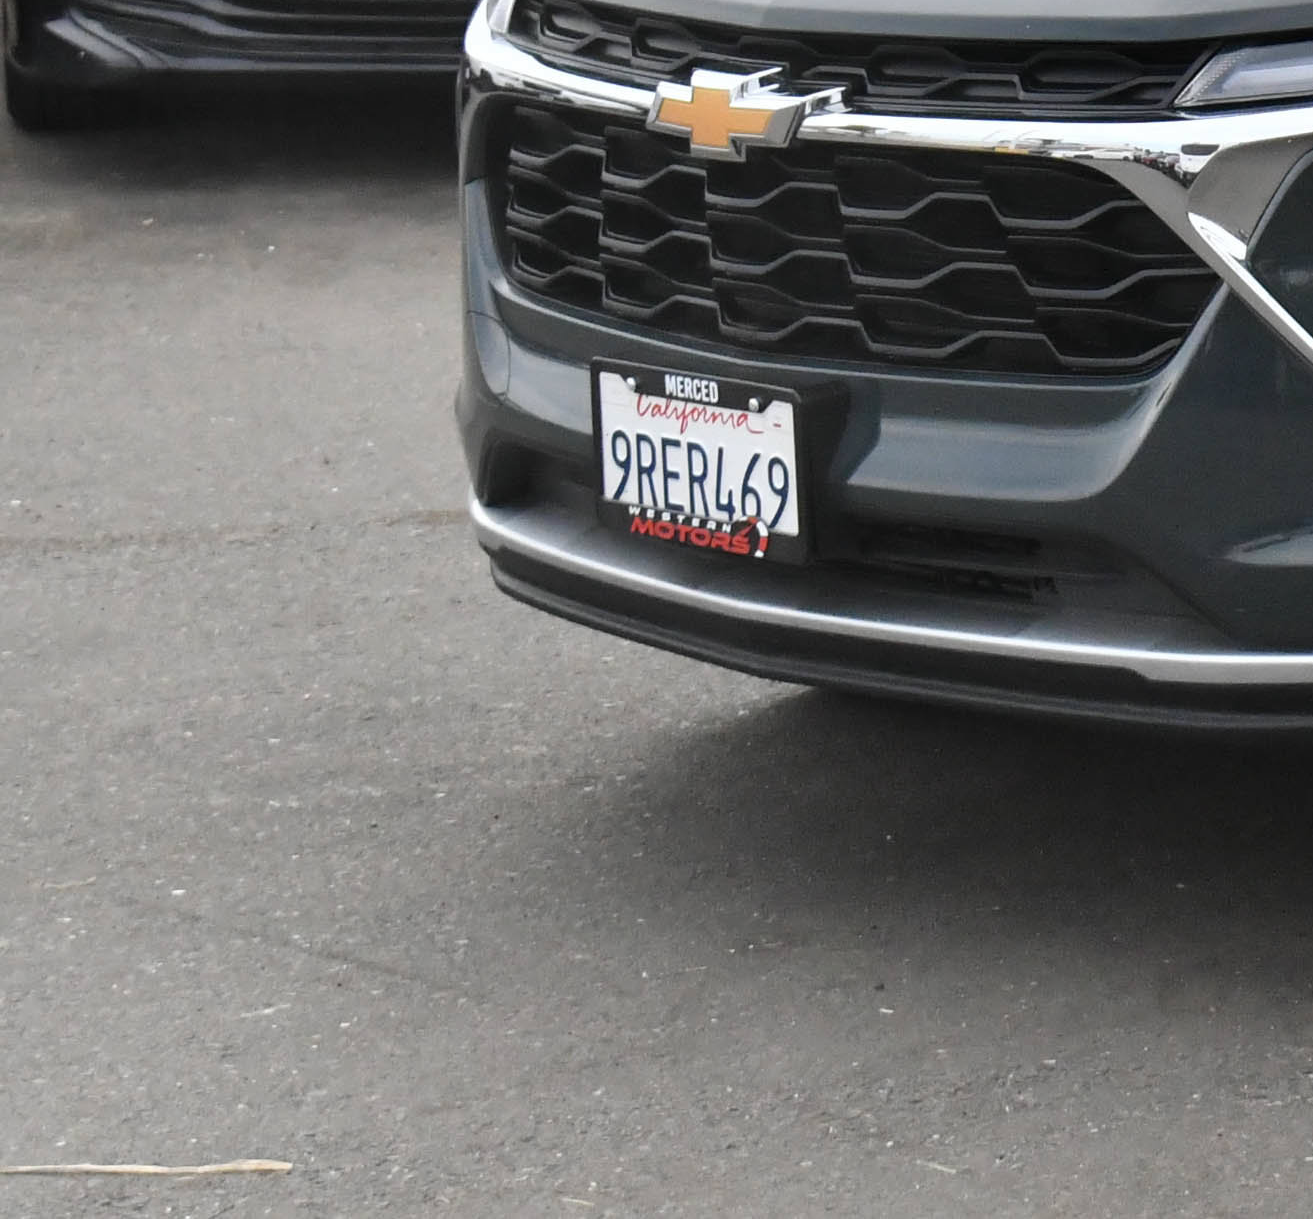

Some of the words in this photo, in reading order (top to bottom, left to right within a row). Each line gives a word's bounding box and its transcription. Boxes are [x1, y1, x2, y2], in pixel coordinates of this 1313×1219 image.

[664, 374, 719, 404] MERCED
[636, 393, 764, 435] California
[611, 429, 790, 529] 9RER469
[629, 505, 732, 533] WESTERN
[630, 516, 750, 556] MOTORS
